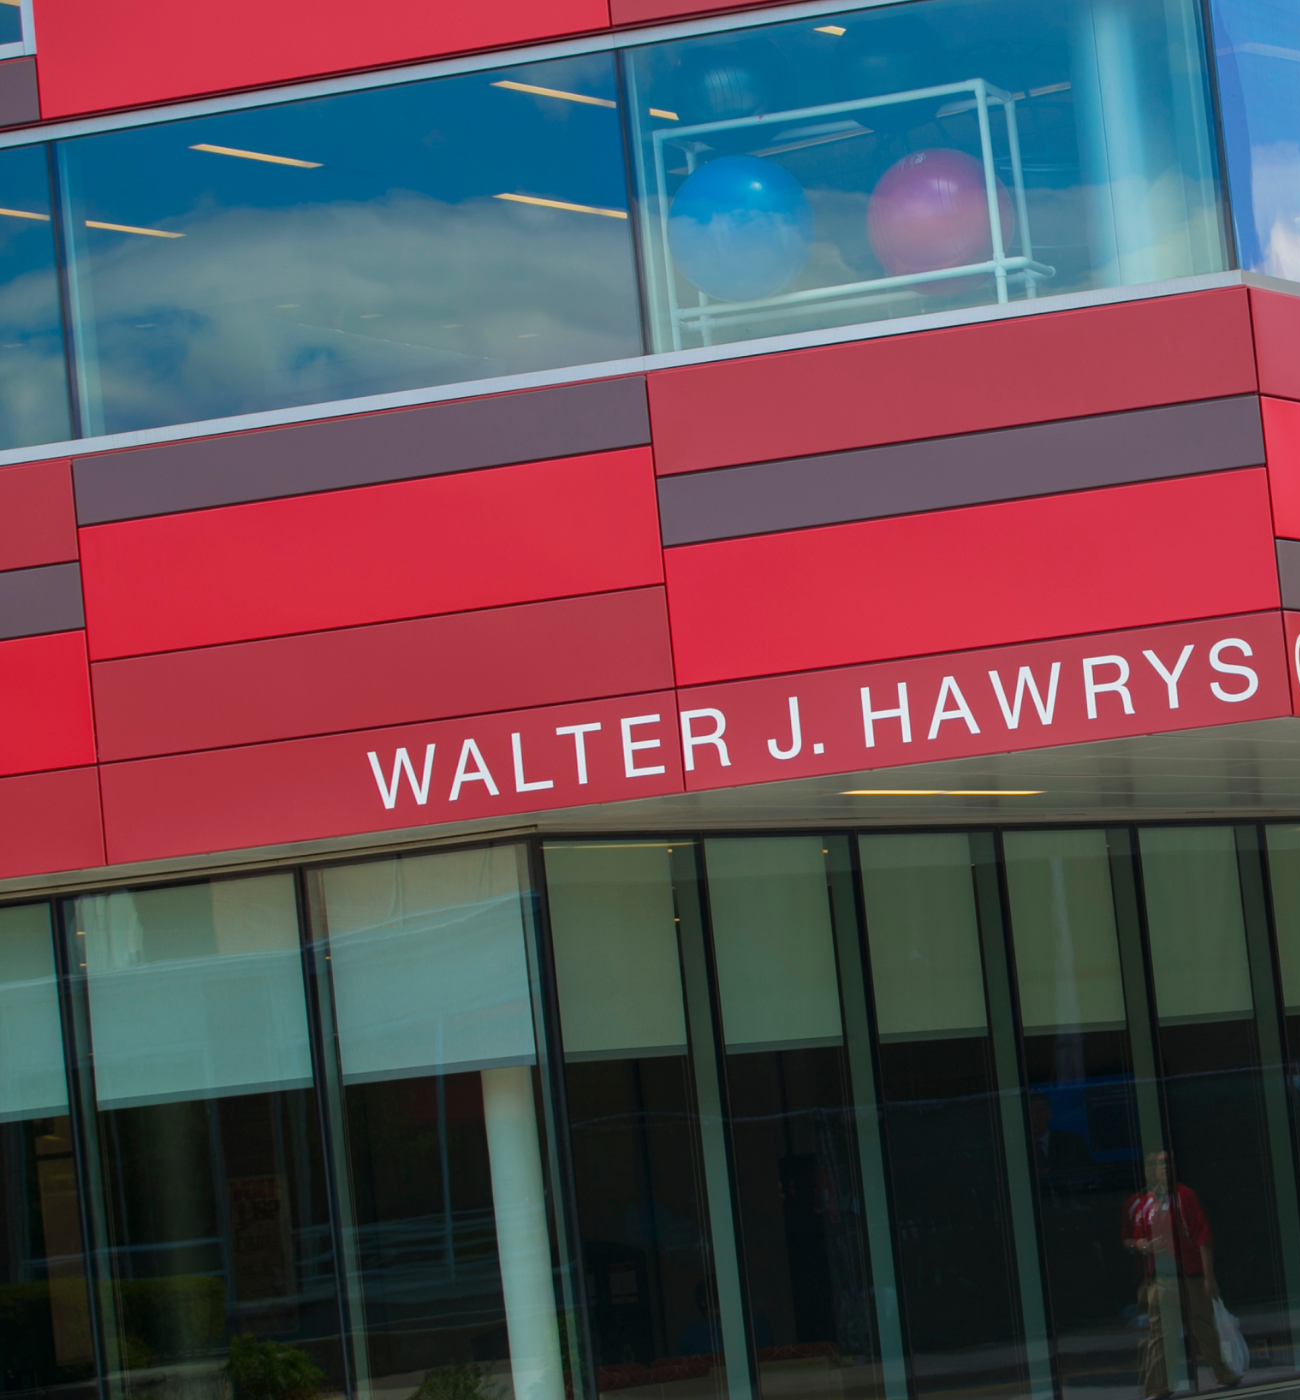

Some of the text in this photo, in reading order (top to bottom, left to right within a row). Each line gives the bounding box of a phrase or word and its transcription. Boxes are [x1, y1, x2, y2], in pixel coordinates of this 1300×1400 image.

[367, 637, 1259, 810] WALTER J. HAWRYS
